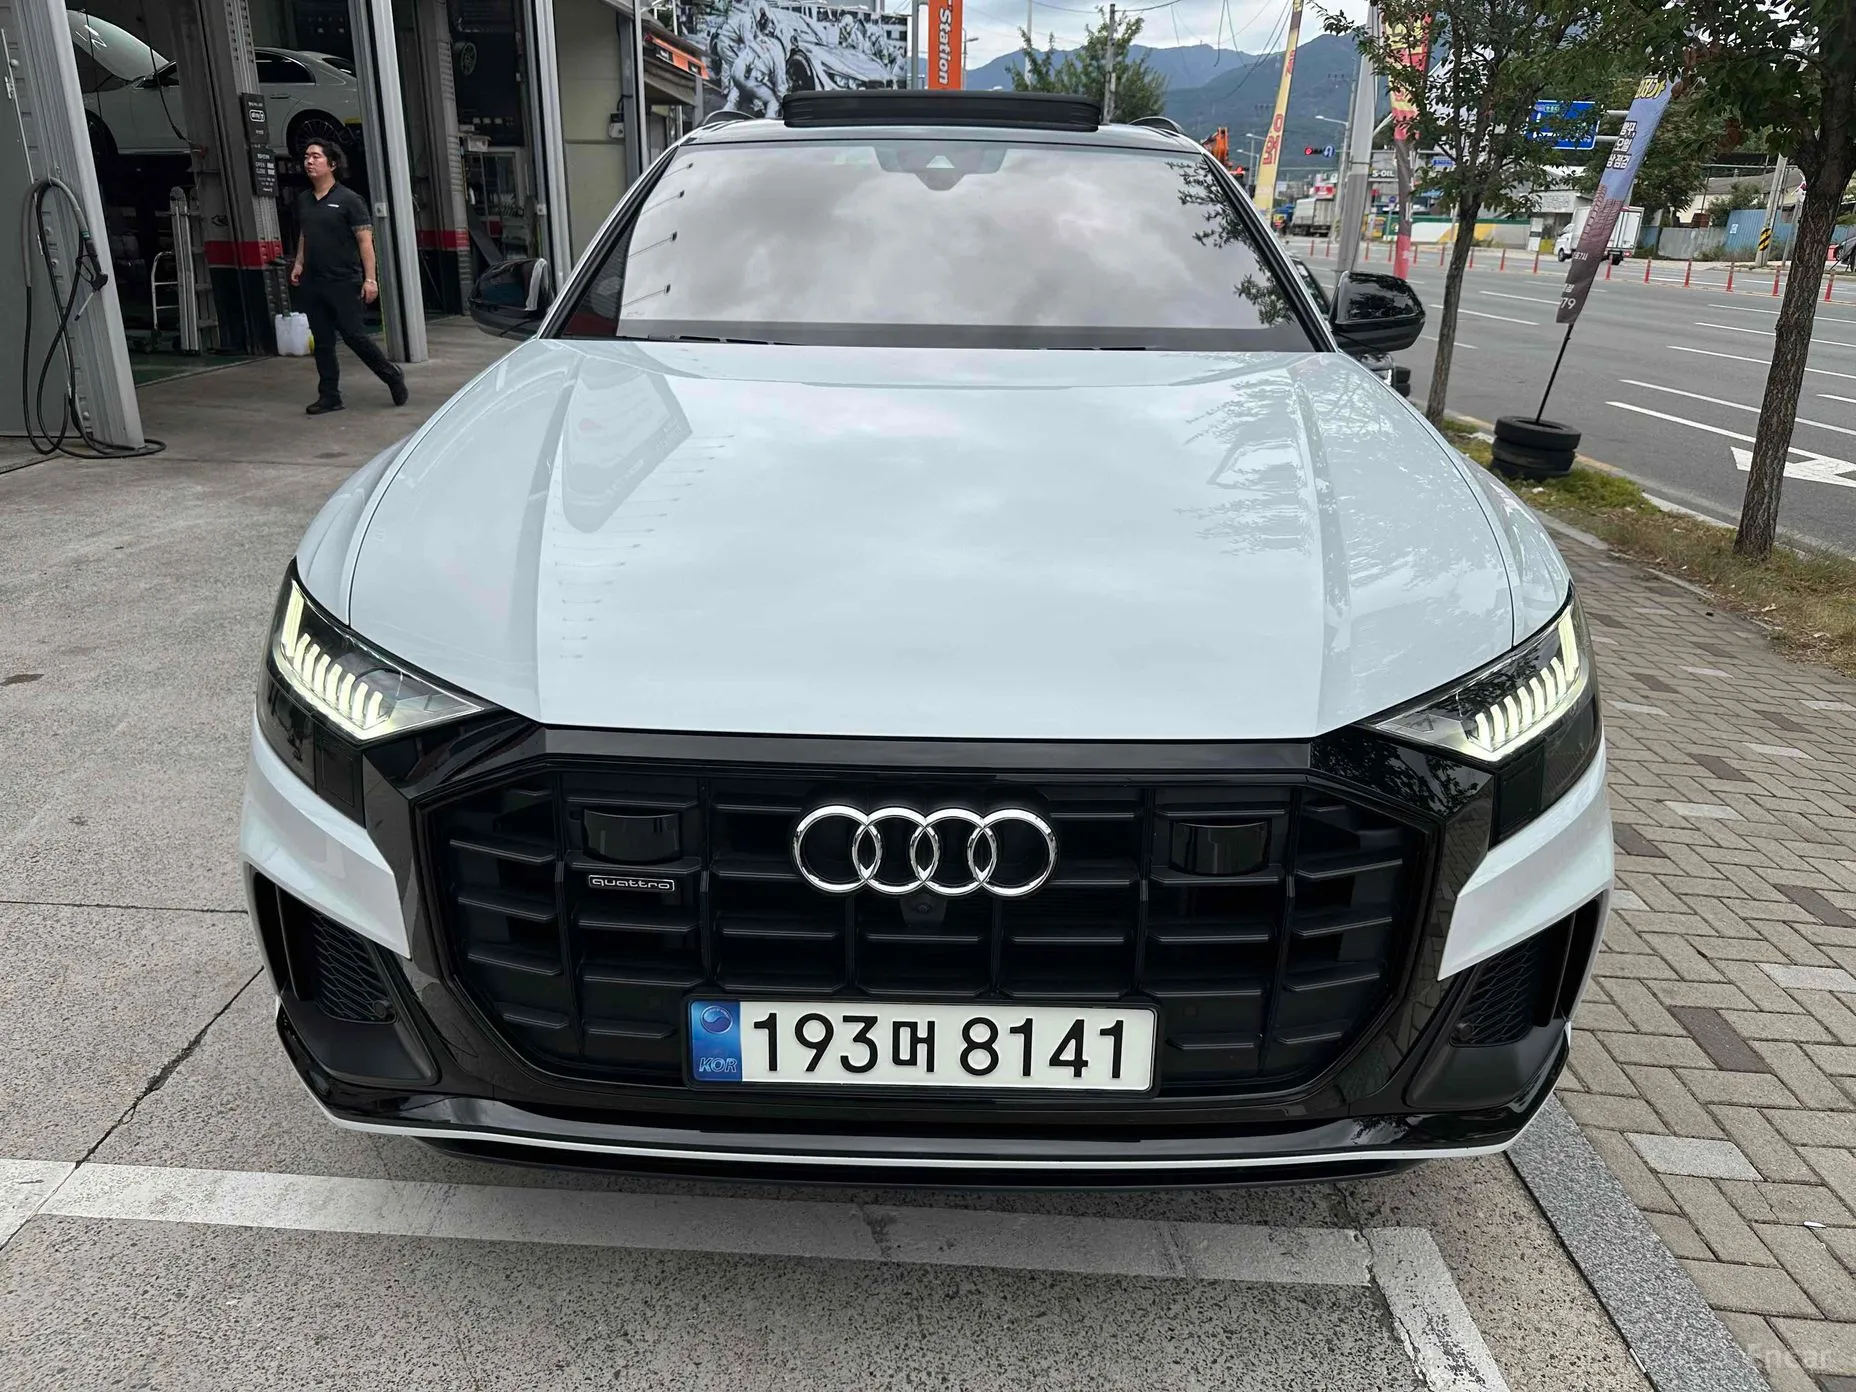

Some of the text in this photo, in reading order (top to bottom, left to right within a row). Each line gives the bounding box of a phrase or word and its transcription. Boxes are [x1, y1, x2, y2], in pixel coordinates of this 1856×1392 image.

[1613, 138, 1632, 152] 오일
[1606, 153, 1631, 169] 상점검
[592, 879, 671, 889] quattro
[752, 1011, 1125, 1079] 193머 8141
[698, 1056, 738, 1073] KOR
